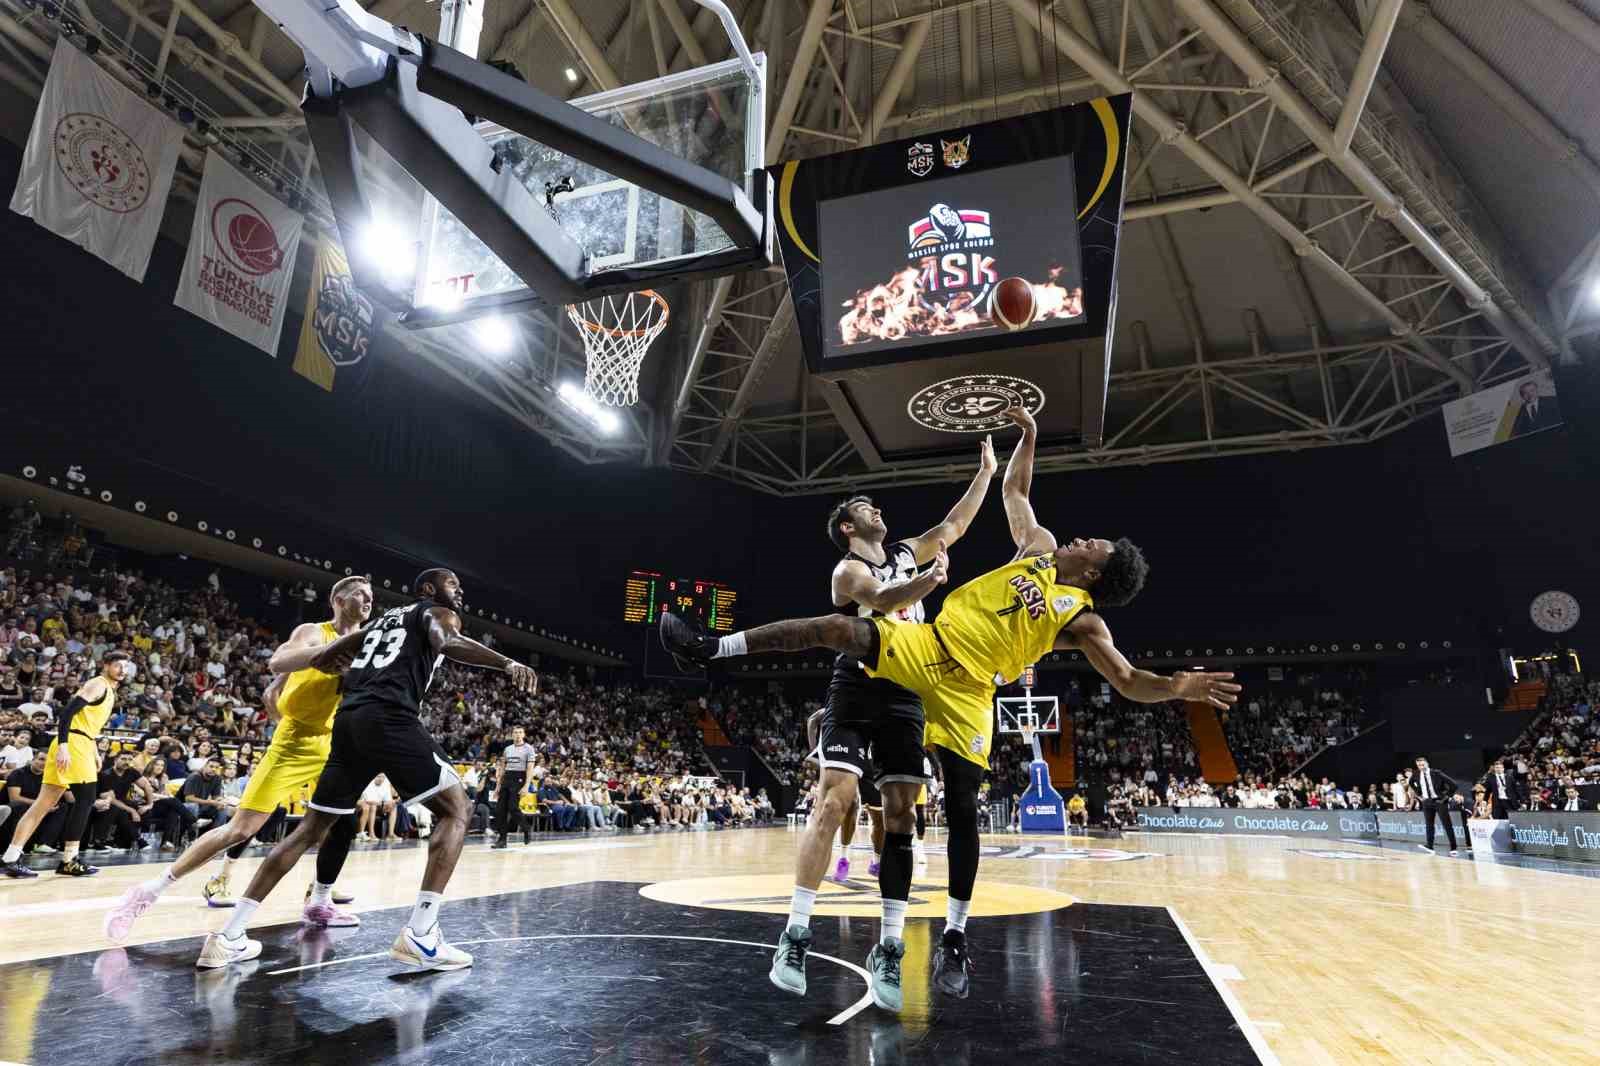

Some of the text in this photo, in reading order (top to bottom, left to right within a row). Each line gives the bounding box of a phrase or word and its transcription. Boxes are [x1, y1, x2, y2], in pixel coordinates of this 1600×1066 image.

[907, 156, 934, 170] MSK
[200, 269, 272, 319] BASKETBOL
[202, 255, 275, 307] TÜRKİYE
[1008, 575, 1047, 620] MSK
[350, 628, 407, 668] 33
[1137, 814, 1224, 828] Chocolate Club
[1233, 816, 1328, 832] Chocolate Club
